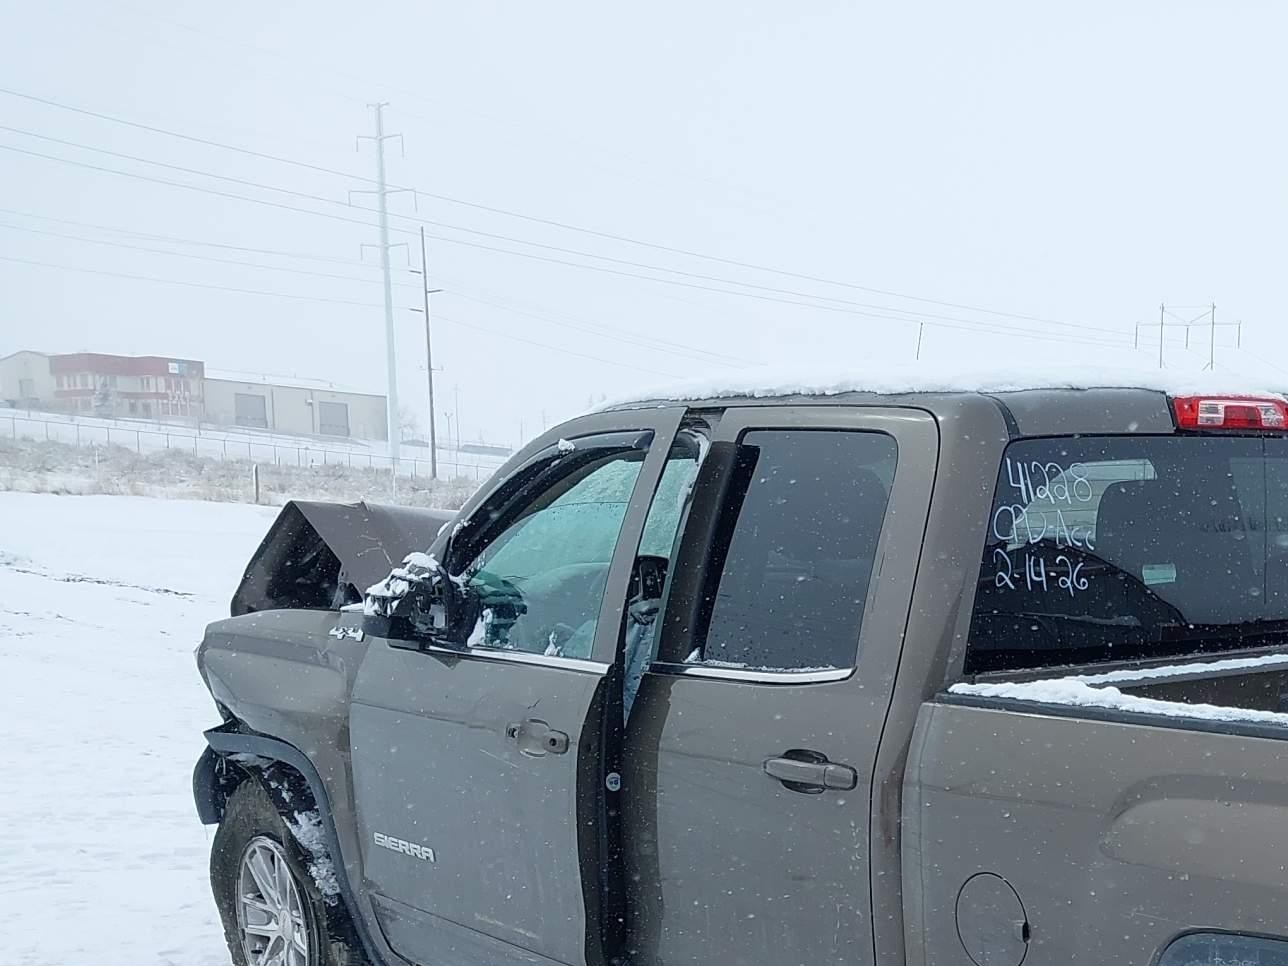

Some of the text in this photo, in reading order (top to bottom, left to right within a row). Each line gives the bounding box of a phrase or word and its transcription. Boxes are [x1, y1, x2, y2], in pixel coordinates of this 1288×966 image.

[1006, 457, 1093, 505] 41228
[993, 548, 1089, 597] 2-14-26
[373, 831, 436, 863] SIERRA
